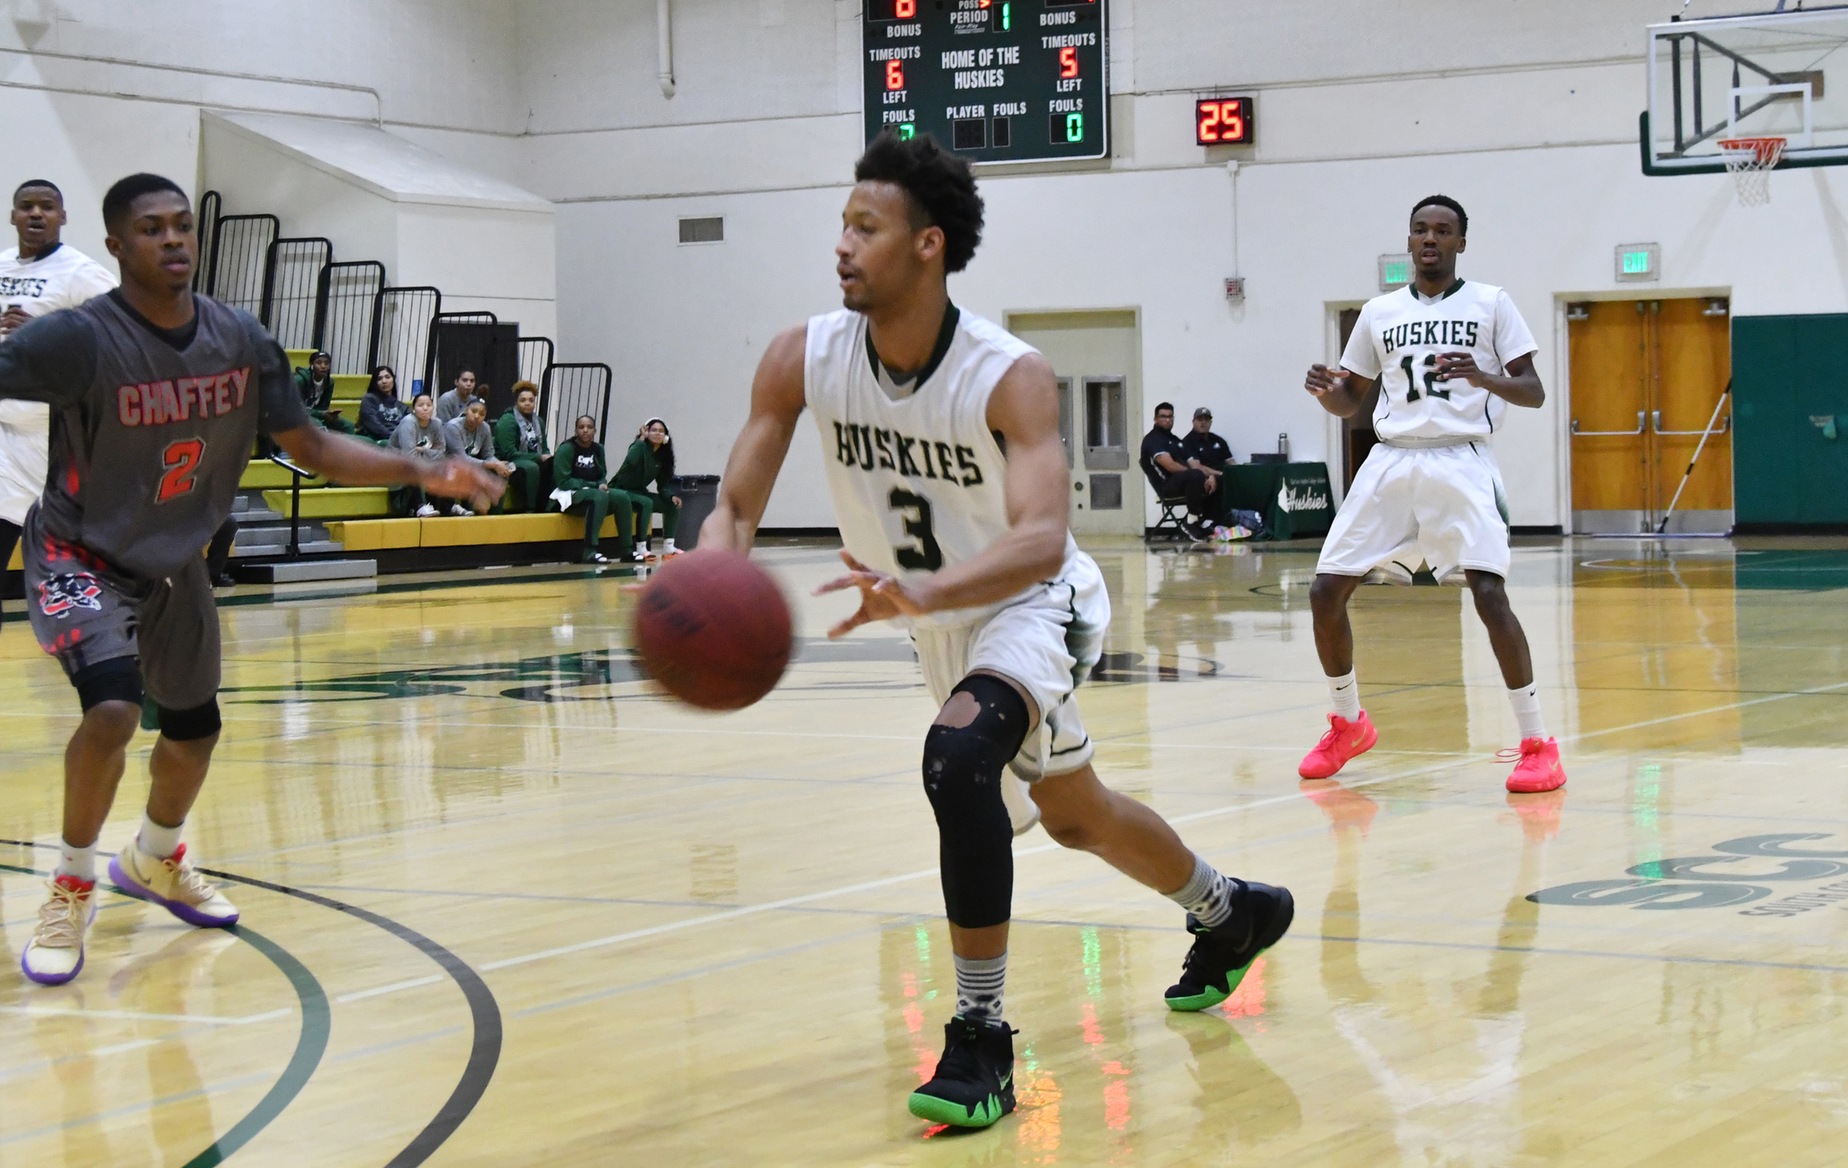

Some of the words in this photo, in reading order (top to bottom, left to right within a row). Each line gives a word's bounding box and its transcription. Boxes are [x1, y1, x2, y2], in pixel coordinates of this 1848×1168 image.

[950, 10, 989, 24] PERIOD
[1002, 3, 1010, 30] 1
[1040, 11, 1076, 26] BONUS
[887, 24, 921, 38] BONUS
[1041, 33, 1096, 48] TIMEOUTS
[869, 46, 921, 61] TIMEOUTS
[941, 50, 975, 69] HOME
[978, 48, 994, 67] OF
[996, 46, 1020, 65] THE
[1060, 48, 1078, 78] 5
[886, 60, 904, 90] 6
[954, 69, 1005, 89] HUSKIES
[1056, 79, 1082, 92] LEFT
[883, 91, 907, 104] LEFT
[1049, 99, 1083, 112] FOULS
[882, 109, 915, 123] FOULS
[946, 105, 985, 119] PLAYER
[993, 102, 1027, 116] FOULS
[1199, 101, 1243, 142] 25
[1067, 113, 1082, 142] 0
[1382, 320, 1479, 354] HUSKIES
[1401, 353, 1450, 402] 12
[117, 366, 252, 427] CHAFFEY
[833, 420, 985, 488] HUSKIES
[155, 436, 206, 504] 2
[1286, 486, 1328, 511] Huskies
[886, 485, 945, 573] 3
